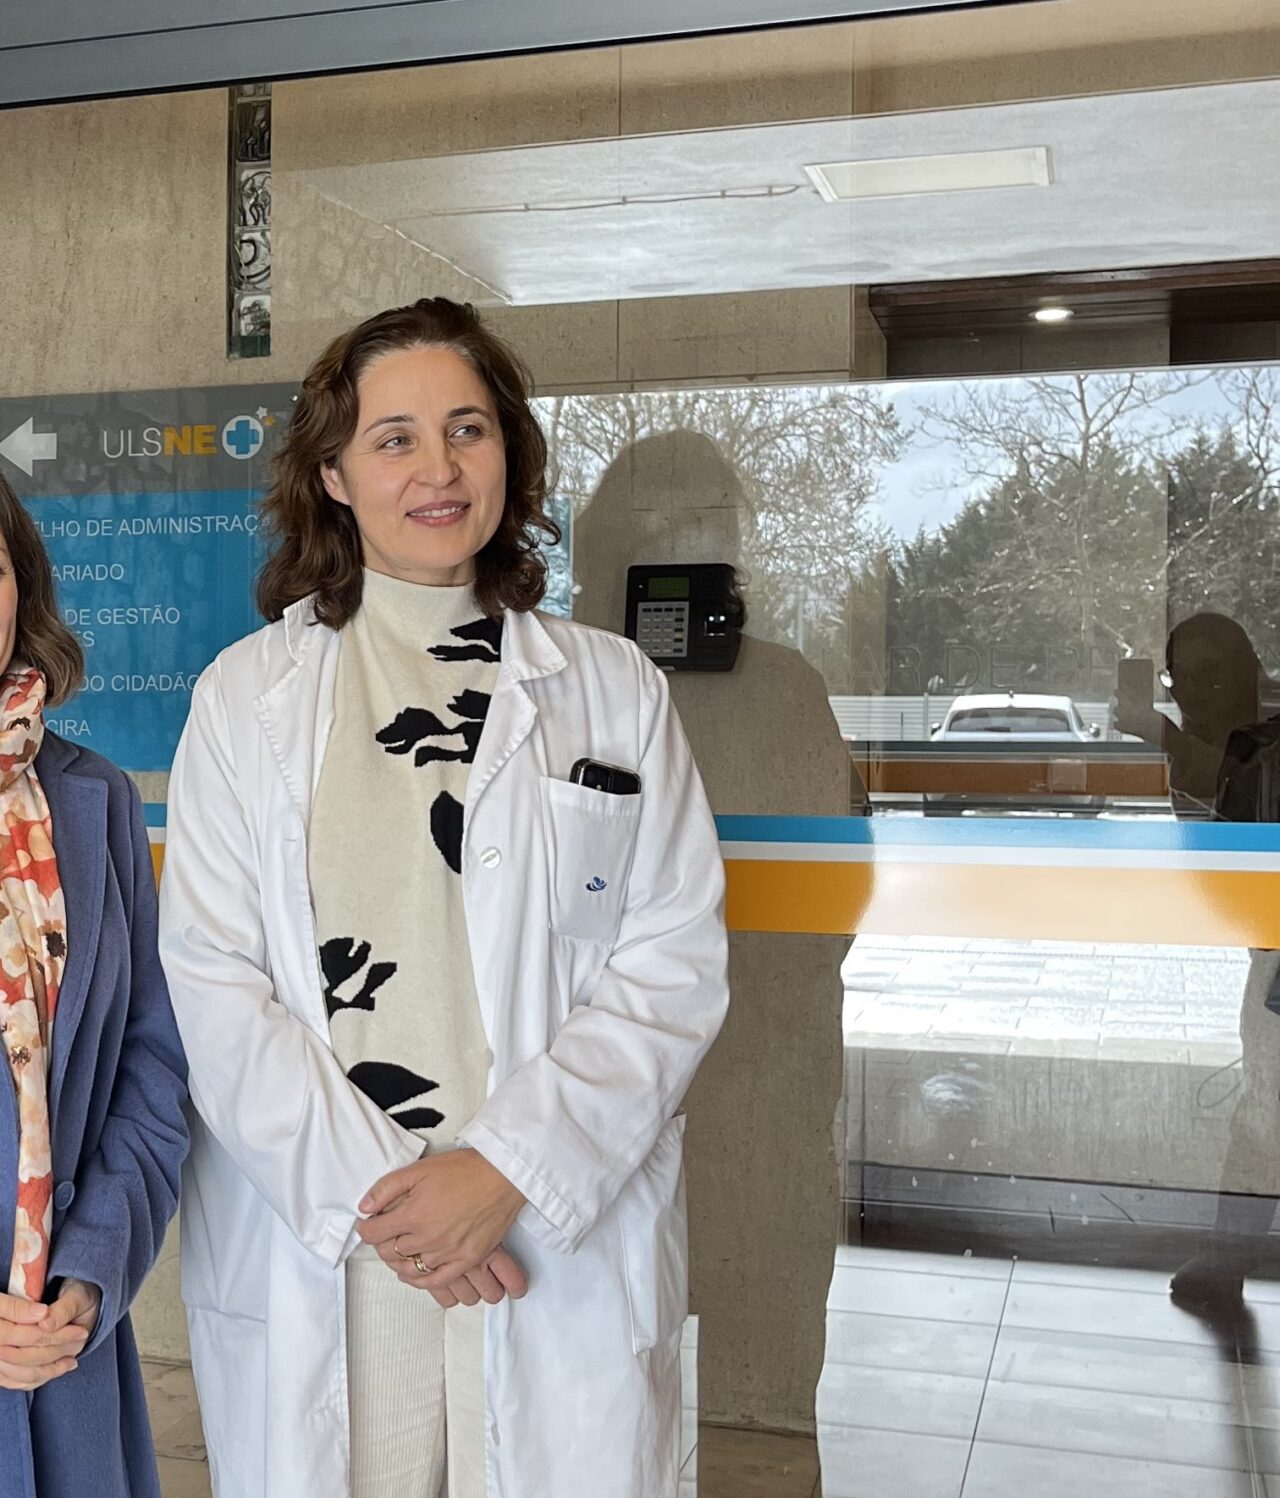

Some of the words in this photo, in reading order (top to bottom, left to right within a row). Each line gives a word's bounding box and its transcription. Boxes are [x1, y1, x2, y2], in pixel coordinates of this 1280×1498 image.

[103, 424, 218, 459] ULSNE
[35, 520, 80, 537] LHO
[86, 519, 113, 537] DE
[51, 563, 125, 581] ARIADO
[64, 608, 92, 626] DE
[97, 603, 181, 625] GESTÃO
